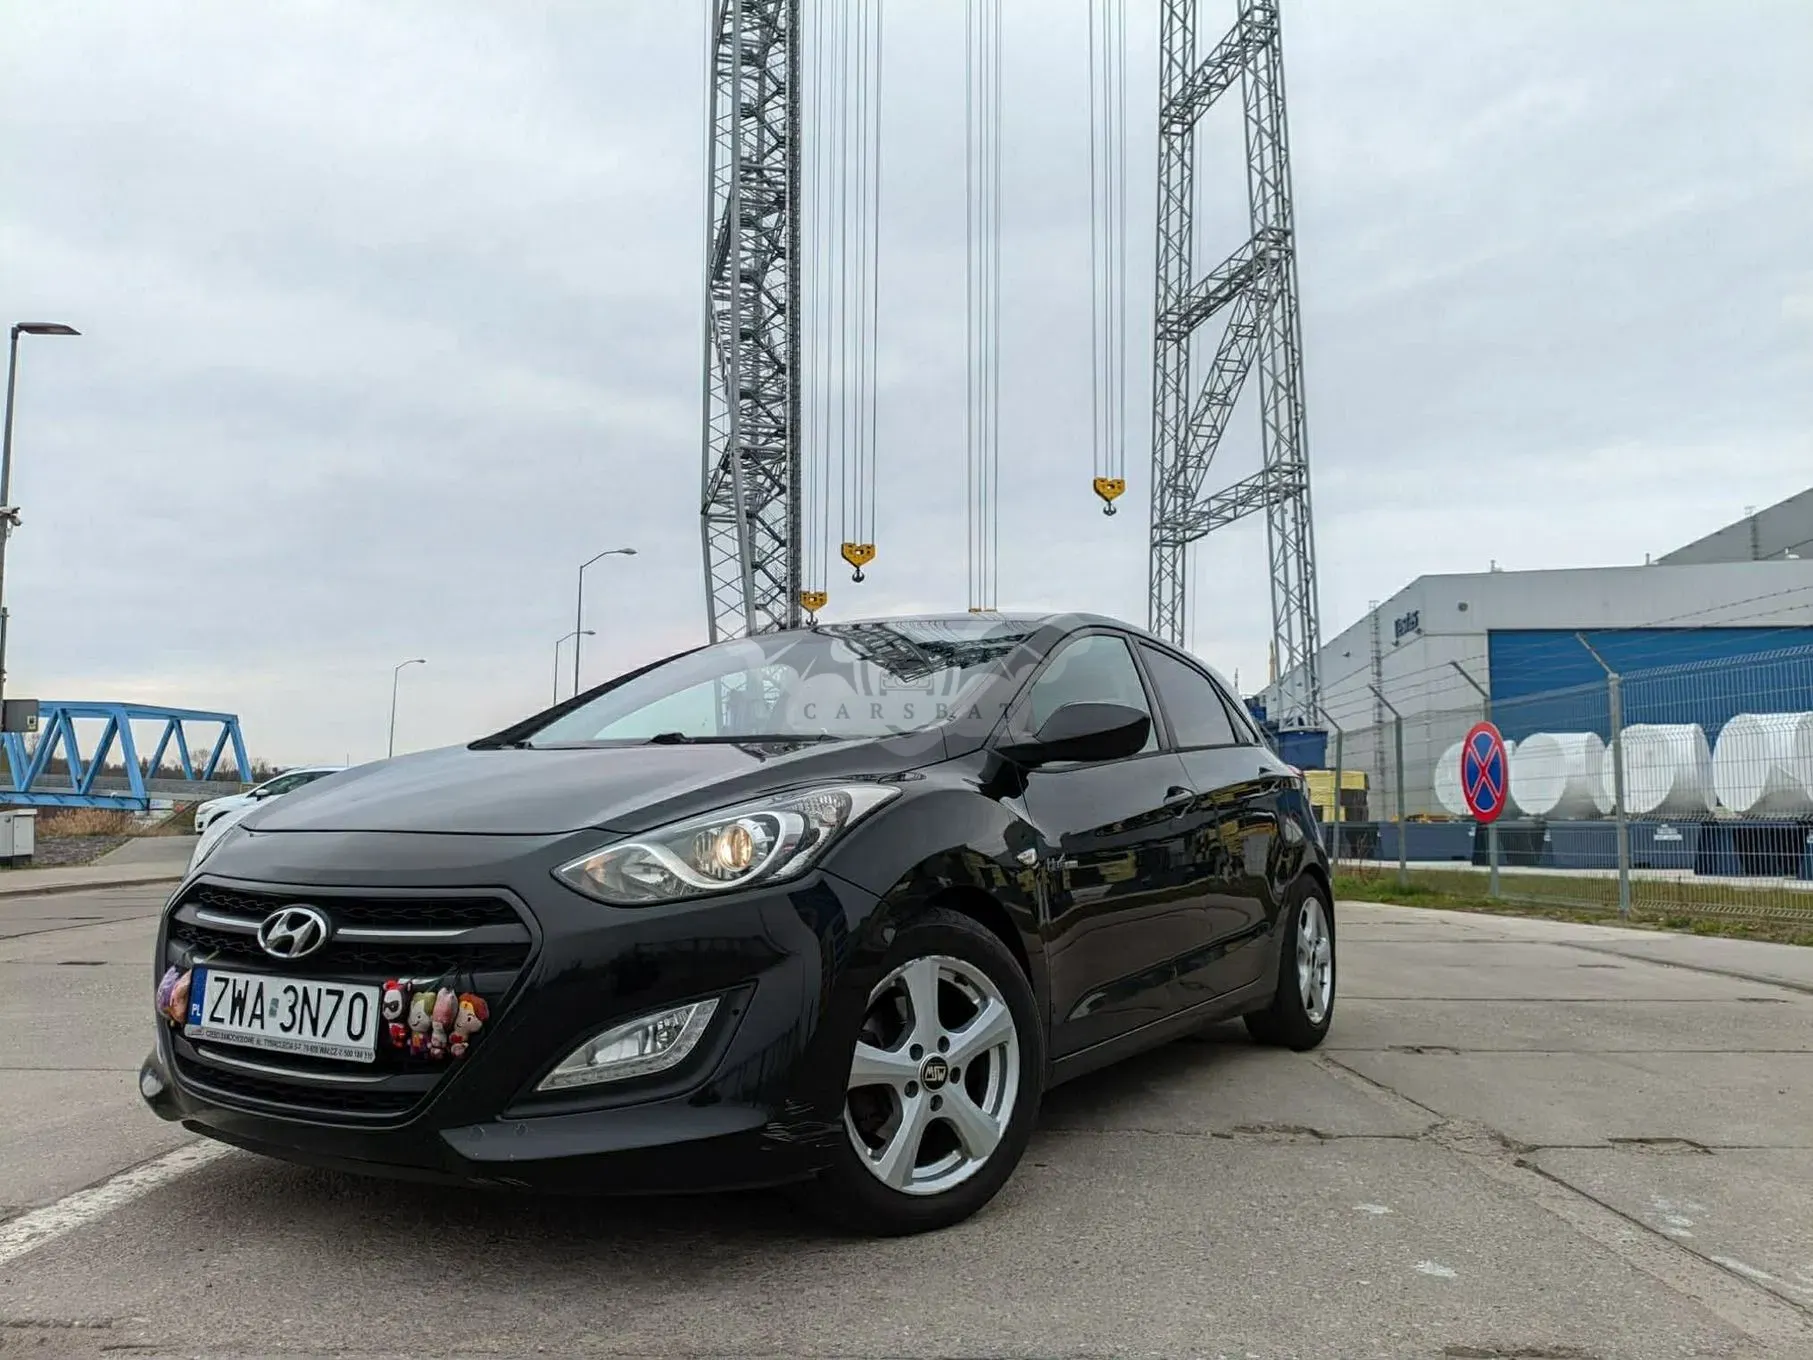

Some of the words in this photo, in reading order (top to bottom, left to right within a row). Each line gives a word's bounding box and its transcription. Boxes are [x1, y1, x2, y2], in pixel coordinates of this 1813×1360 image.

[191, 1003, 201, 1016] PL
[209, 976, 265, 1030] ZWA
[279, 984, 368, 1041] 3N70
[925, 1065, 946, 1081] MSW
